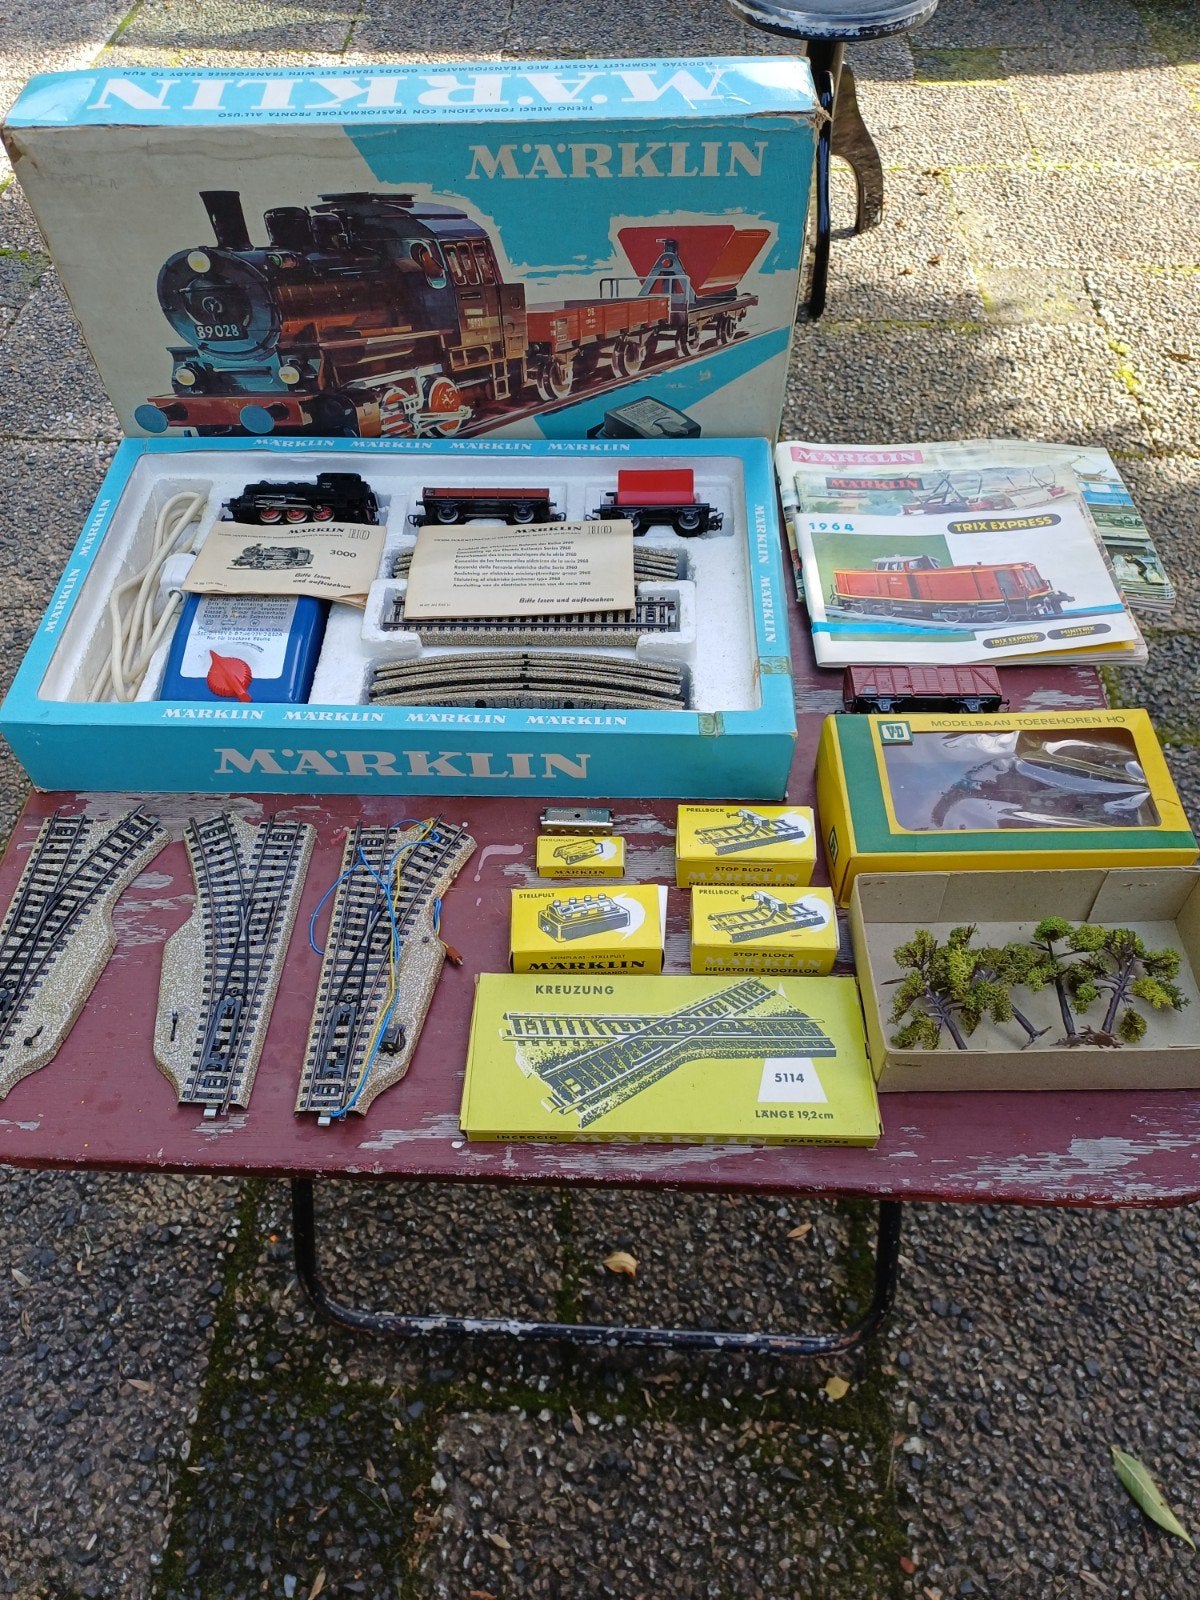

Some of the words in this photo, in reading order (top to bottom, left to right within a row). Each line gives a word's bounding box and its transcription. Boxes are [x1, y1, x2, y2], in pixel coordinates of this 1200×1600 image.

[87, 68, 736, 111] MÄRKLIN
[465, 142, 768, 180] MÄRKLIN
[197, 324, 240, 340] 89028
[253, 438, 336, 448] MÄRKLIN
[350, 440, 432, 449] MÄRKLIN
[449, 442, 532, 450] MÄRKLIN
[547, 443, 630, 451] MÄRKLIN
[289, 526, 344, 535] MÄRKLIN
[514, 526, 582, 534] MÄRKLIN
[808, 522, 854, 532] 1964
[954, 520, 987, 533] TRIX
[990, 516, 1054, 531] EXPRESS
[755, 504, 770, 564] MÄRKLIN
[330, 549, 357, 558] 3000
[44, 568, 81, 634] MÄRKLIN
[78, 499, 112, 557] MÄRKLIN
[760, 575, 777, 643] MÄRKLIN
[1060, 626, 1096, 635] MINITRIX
[162, 708, 264, 720] MÄRKLIN
[282, 711, 384, 722] MÄRKLIN
[405, 713, 506, 724] MÄRKLIN
[525, 715, 628, 726] MÄRKLIN
[930, 720, 1011, 728] MODELBAAN
[214, 748, 591, 779] MÄRKLIN
[528, 960, 646, 971] MÄRKLIN
[535, 985, 614, 995] KREUZUNG
[774, 1072, 805, 1083] 5114
[755, 1109, 794, 1119] LÄNGE
[570, 1134, 767, 1146] MÄRKLIN
